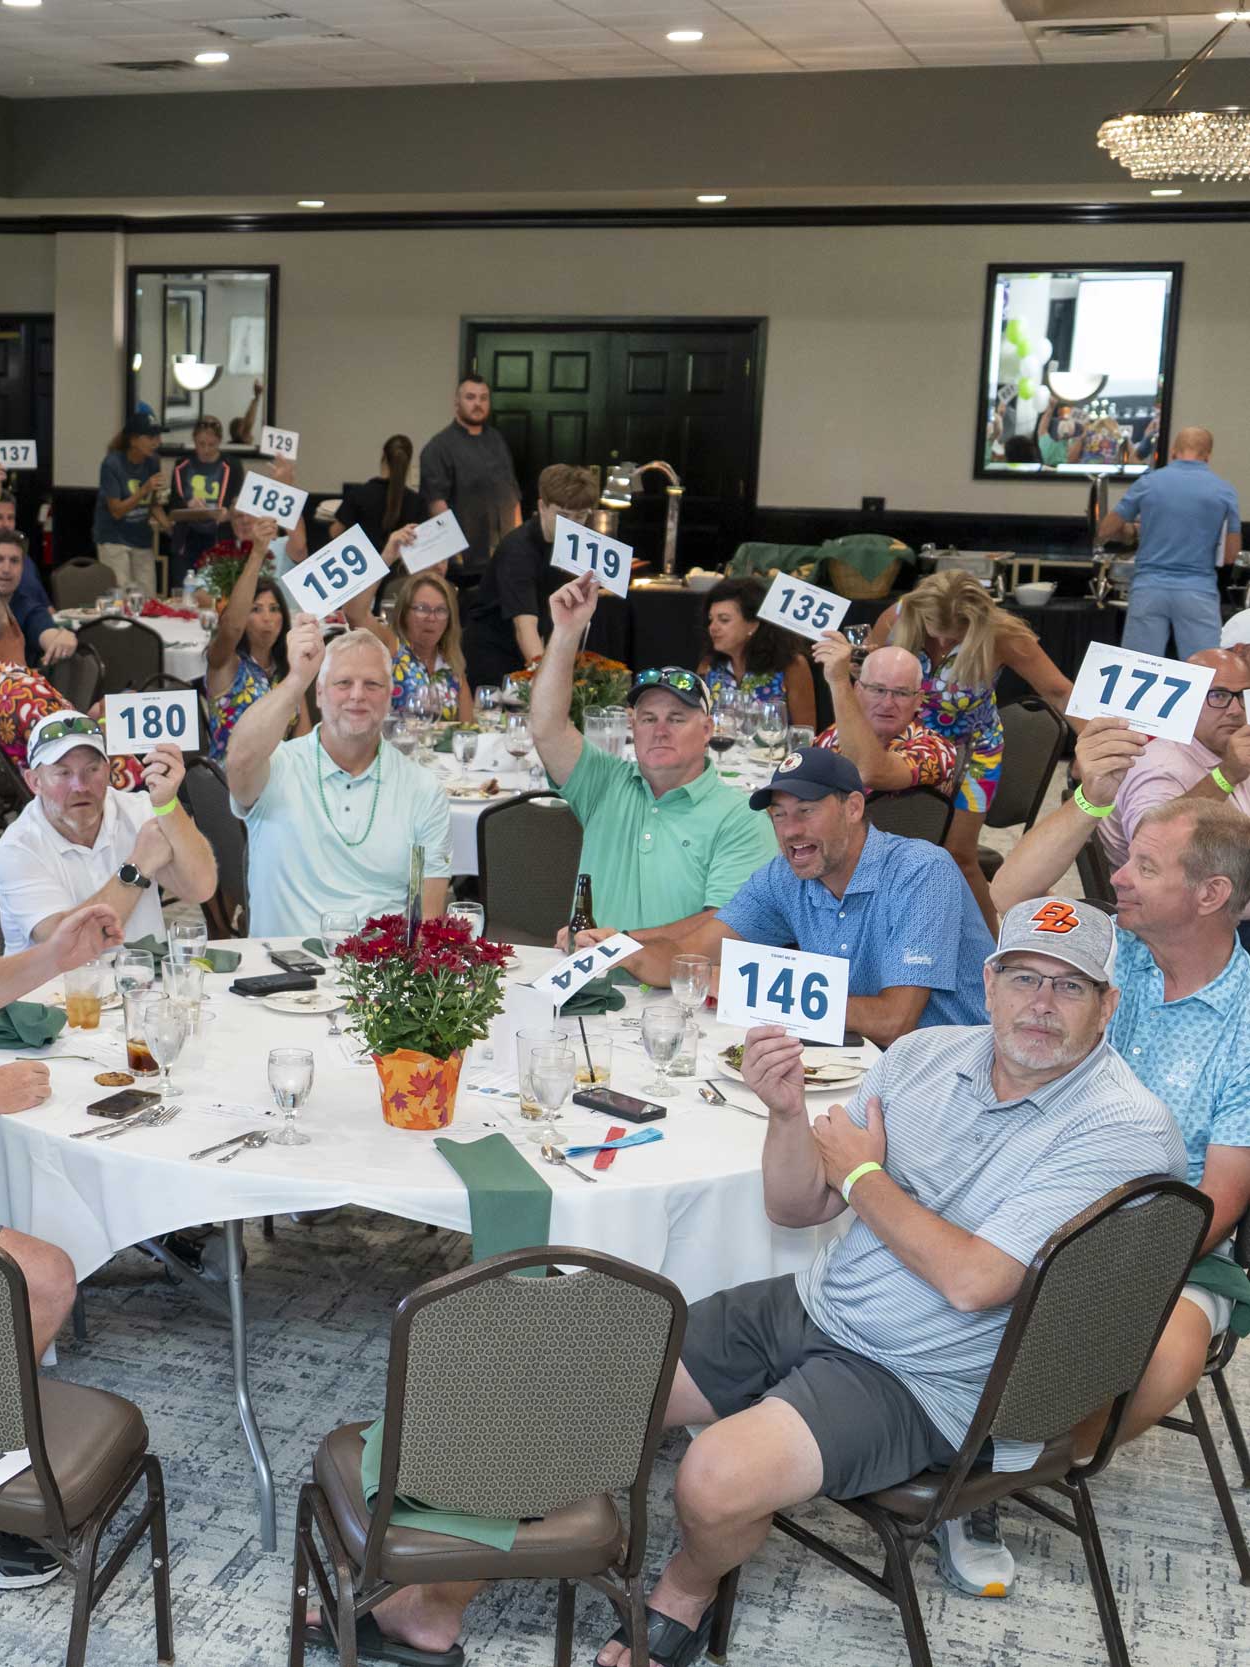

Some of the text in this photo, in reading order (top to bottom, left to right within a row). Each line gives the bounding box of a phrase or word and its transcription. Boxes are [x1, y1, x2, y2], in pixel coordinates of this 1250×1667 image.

[0, 446, 30, 461] 137
[268, 434, 293, 452] 129
[252, 484, 295, 517] 183
[303, 544, 368, 601] 159
[566, 534, 620, 579] 119
[779, 588, 836, 629] 135
[1099, 664, 1192, 719] 177
[119, 703, 186, 739] 180
[551, 945, 622, 990] 144
[738, 962, 829, 1021] 146
